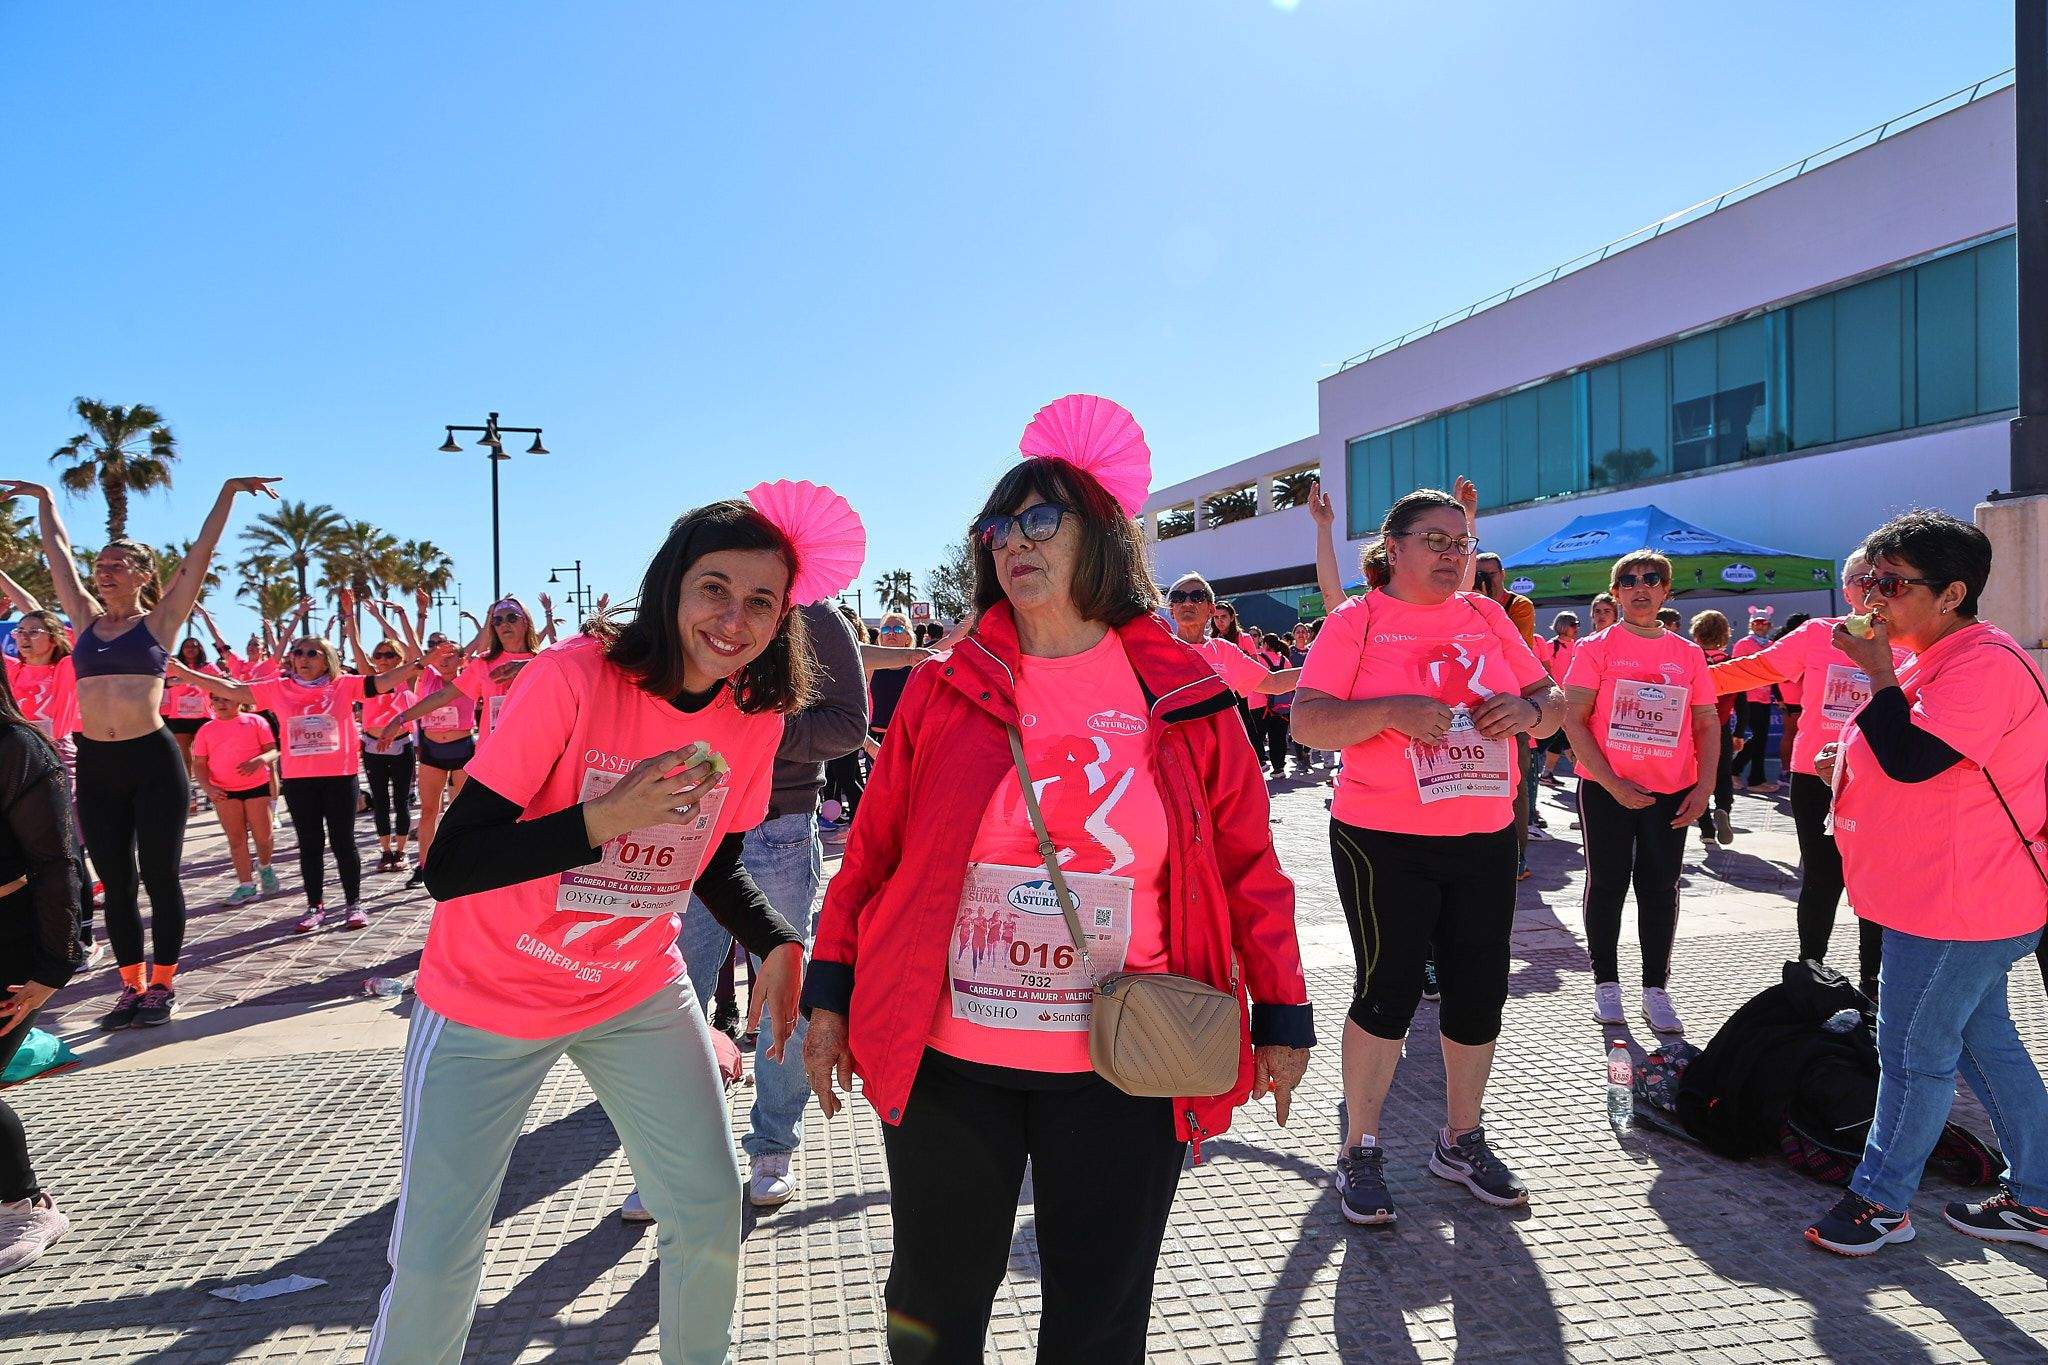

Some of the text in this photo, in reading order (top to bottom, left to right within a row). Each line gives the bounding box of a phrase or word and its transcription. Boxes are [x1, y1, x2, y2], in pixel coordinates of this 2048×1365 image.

[1851, 692, 1868, 701] 01
[1637, 710, 1663, 721] 016
[1092, 718, 1142, 731] ASTURIANA
[1449, 745, 1485, 760] 016
[619, 842, 675, 867] 016
[573, 876, 605, 887] CARRERA
[608, 881, 618, 889] DE
[624, 870, 650, 881] 7937
[565, 891, 614, 906] OYSHO
[515, 933, 580, 971] CARRERA
[1009, 941, 1075, 969] 016
[575, 966, 602, 983] 2025
[1020, 974, 1052, 988] 7932
[969, 985, 1092, 1002] CARRERA DE LA MUJER VALENC
[968, 1001, 1018, 1020] OYSHO
